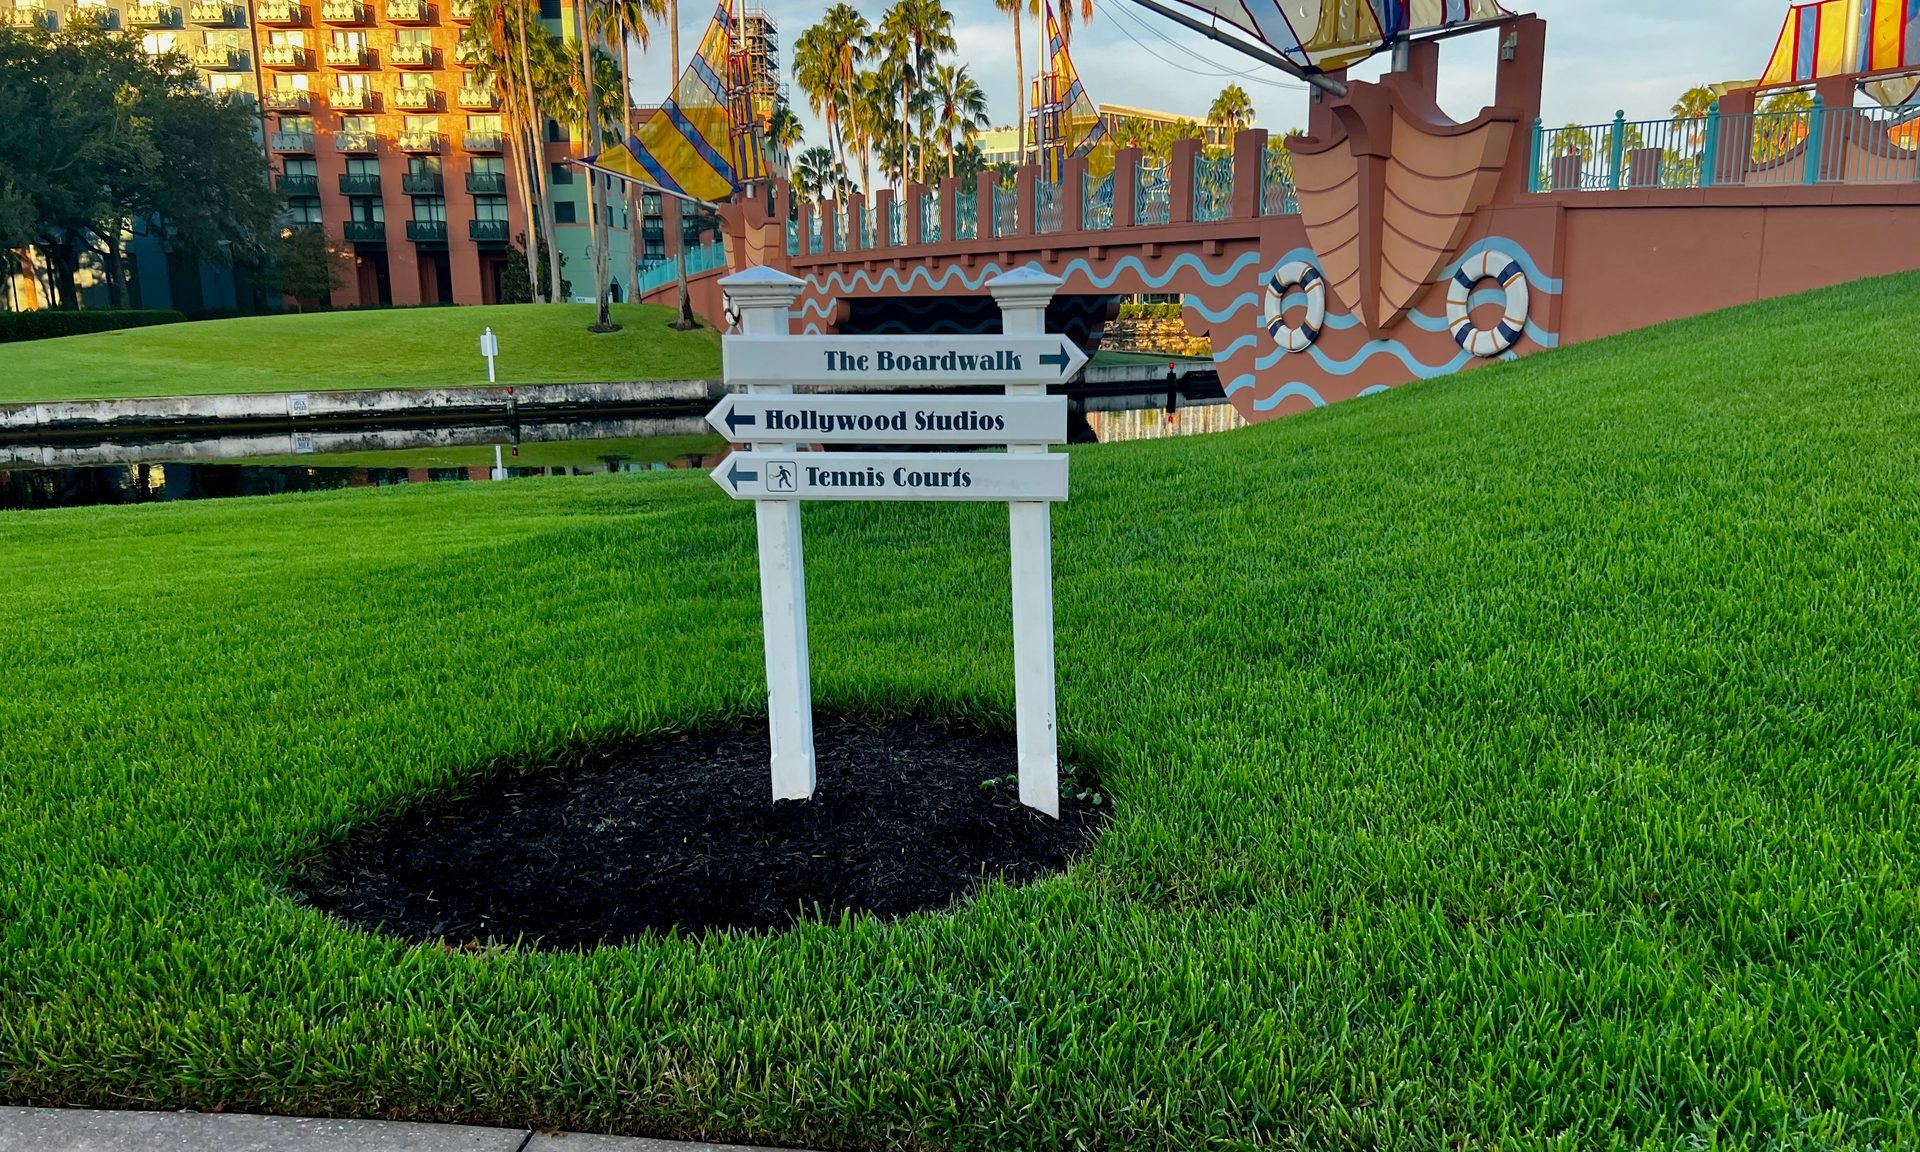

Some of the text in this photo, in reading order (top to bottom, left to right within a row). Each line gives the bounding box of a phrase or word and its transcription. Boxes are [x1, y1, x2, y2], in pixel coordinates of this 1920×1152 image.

[823, 350, 1022, 372] The Boardwalk
[765, 409, 1005, 433] Hollywood Studios
[805, 466, 972, 488] Tennis Courts
